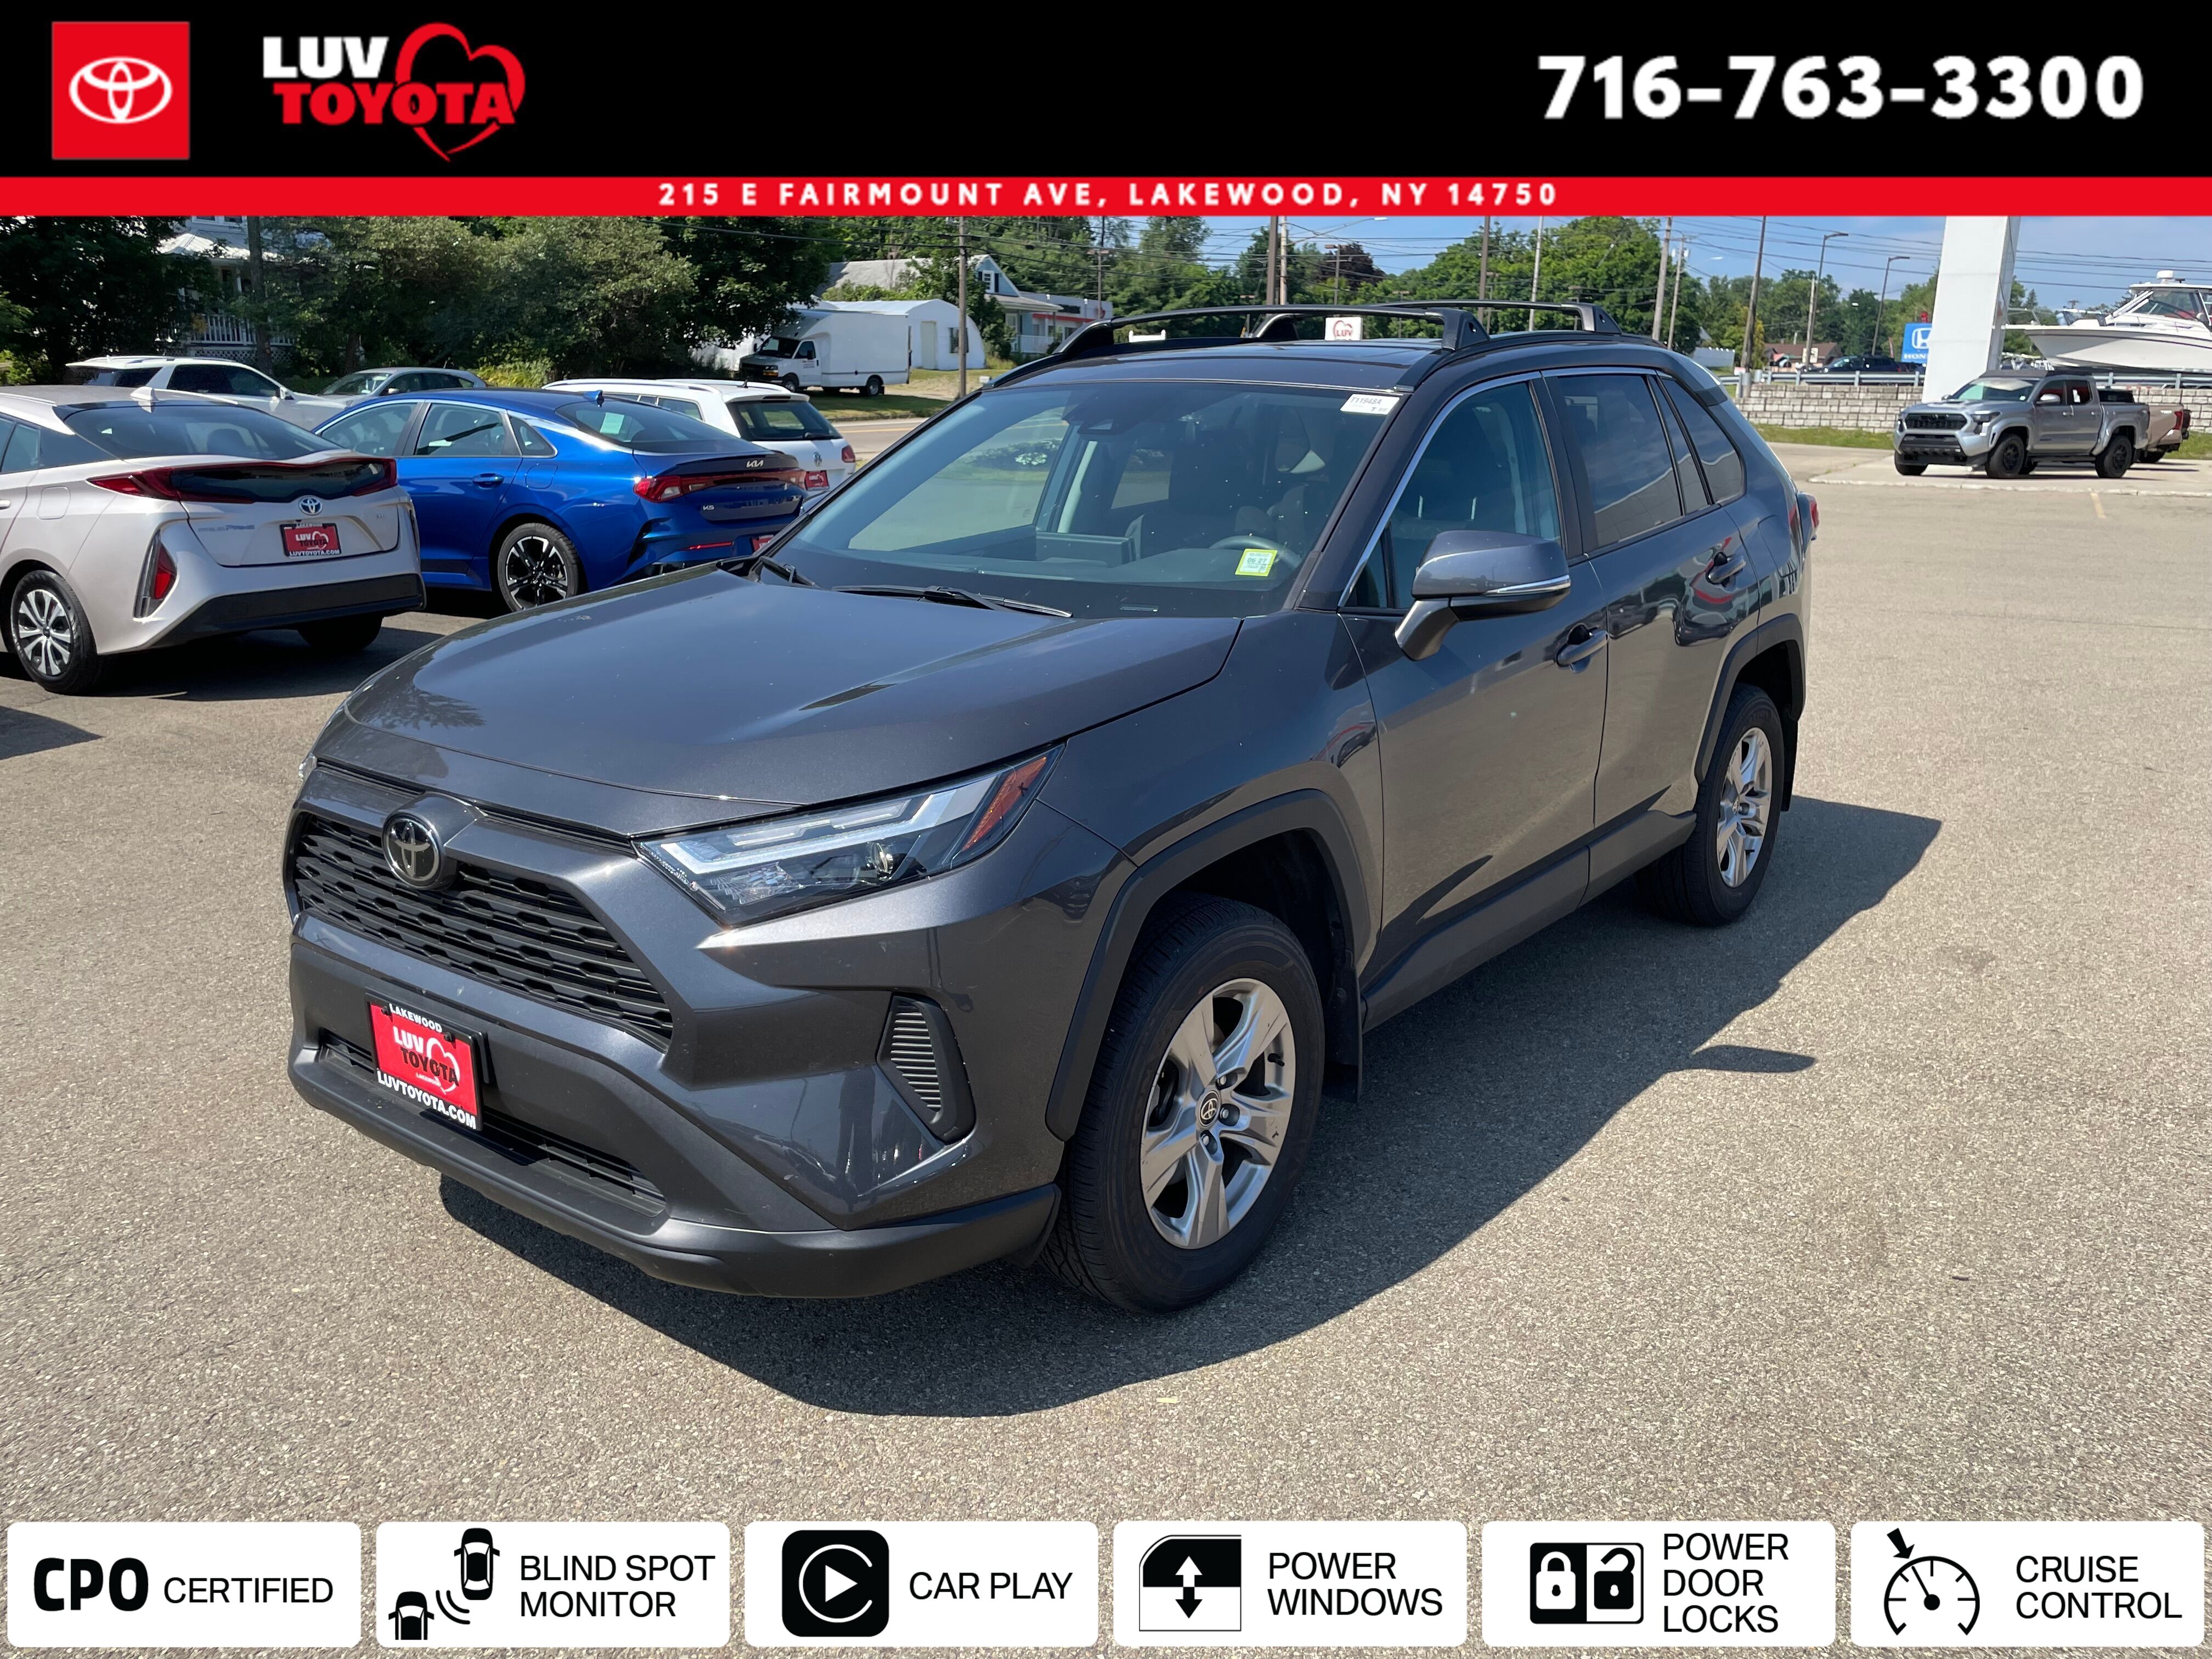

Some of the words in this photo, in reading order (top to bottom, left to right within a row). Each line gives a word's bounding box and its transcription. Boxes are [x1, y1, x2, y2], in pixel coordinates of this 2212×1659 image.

[300, 539, 328, 547] TOYOTA
[389, 1003, 442, 1033] LAKEWOOD
[393, 1026, 424, 1054] LUV
[400, 1046, 459, 1086] TOYOTA
[377, 1071, 476, 1130] LUVTOYOTA.COM
